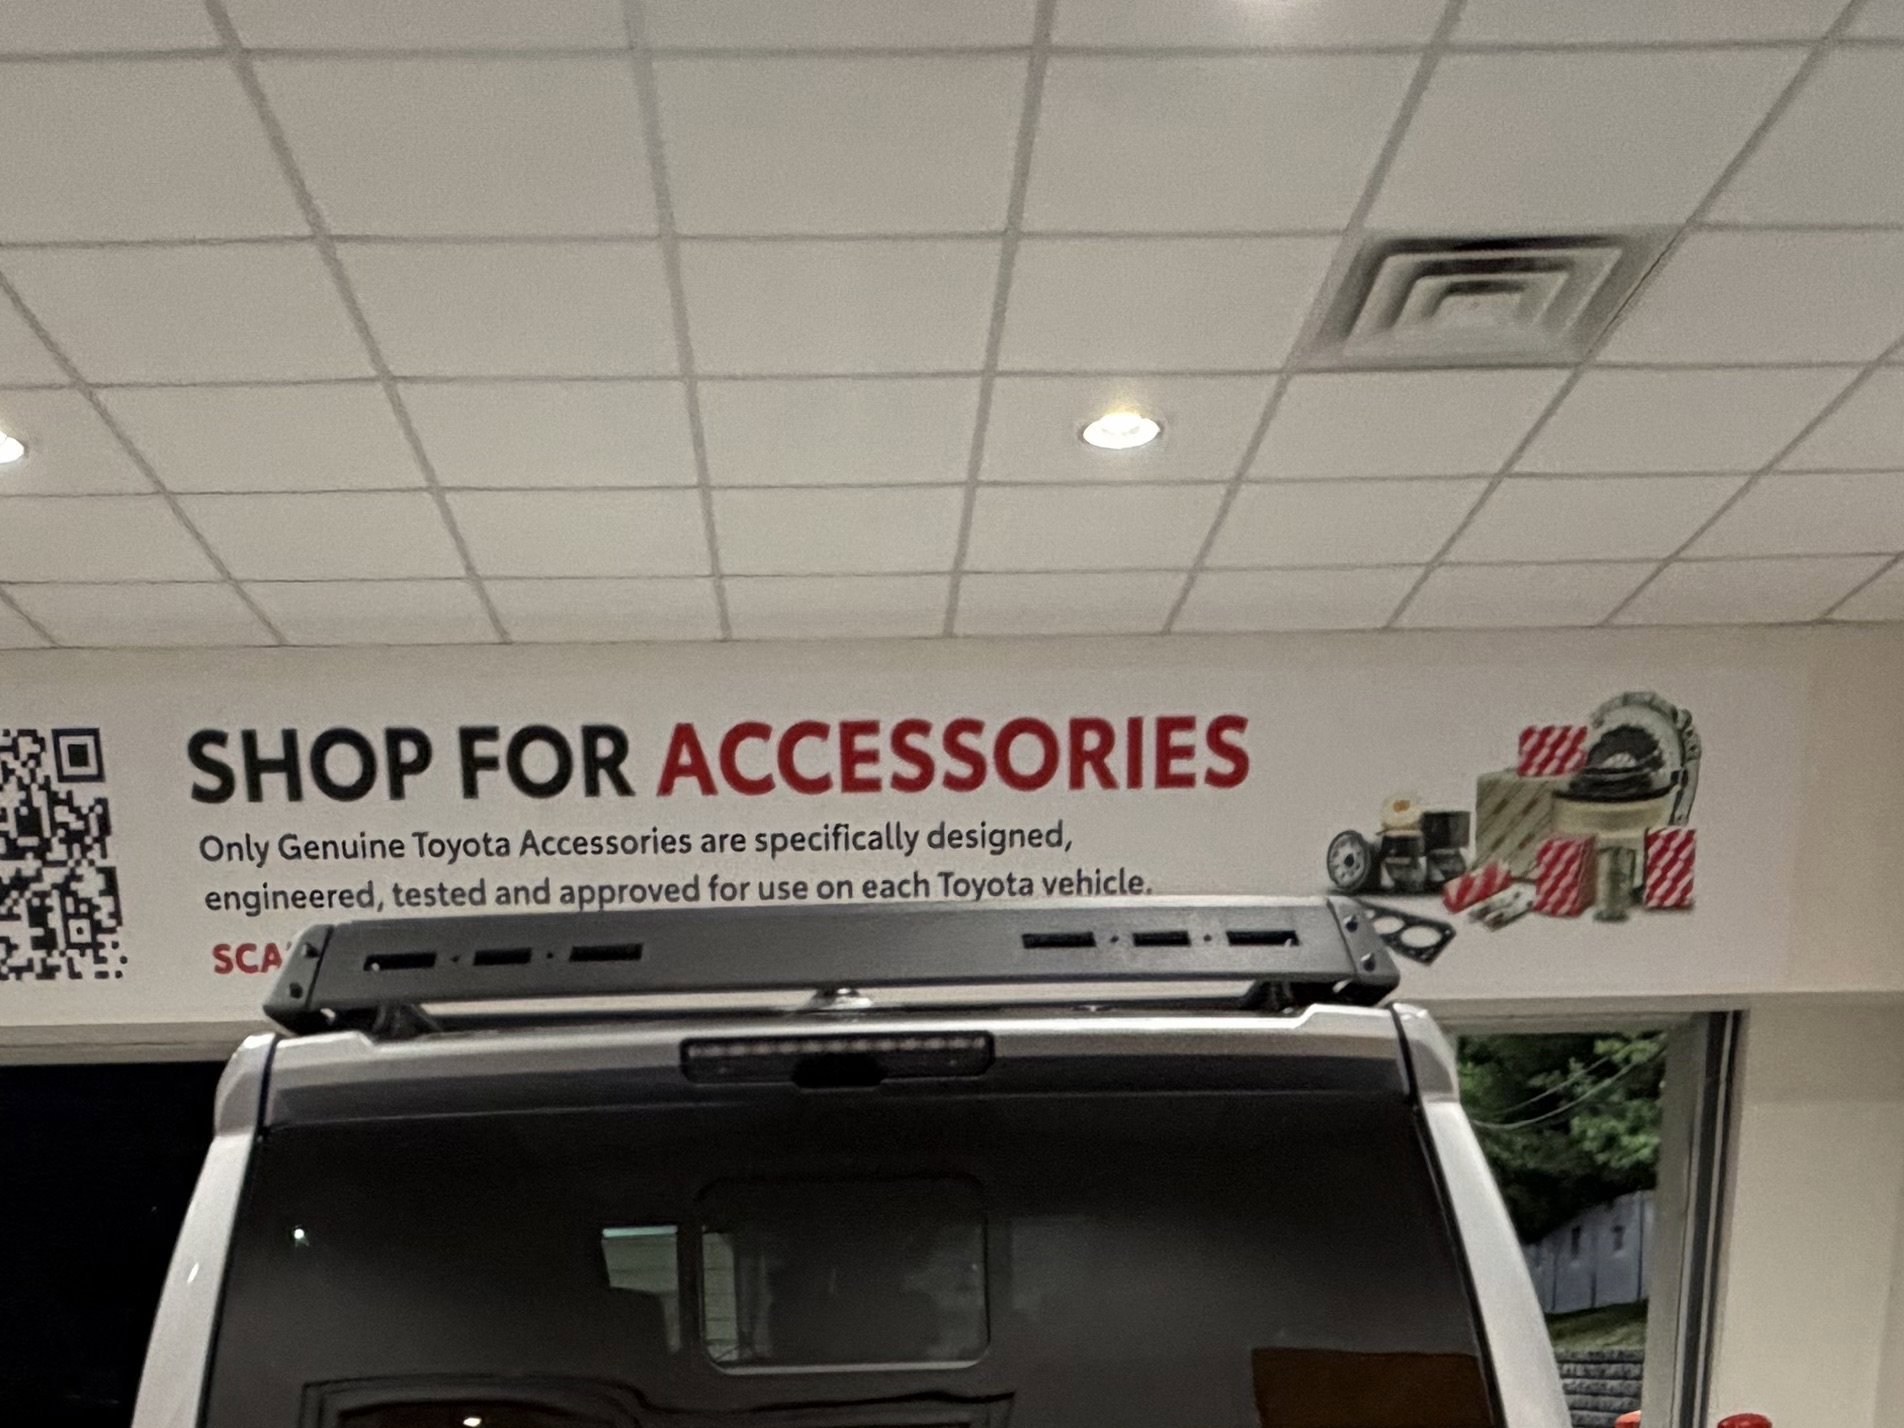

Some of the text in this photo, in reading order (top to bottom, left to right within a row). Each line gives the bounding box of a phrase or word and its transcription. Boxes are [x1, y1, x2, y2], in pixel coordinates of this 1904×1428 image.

[186, 714, 1252, 804] SHOP FOR ACCESSORIES
[199, 819, 1073, 868] Only Genuine Toyota Accessories are specifically designed,
[205, 867, 1153, 917] engineered, tested and approved for use on each Toyota vehicle.
